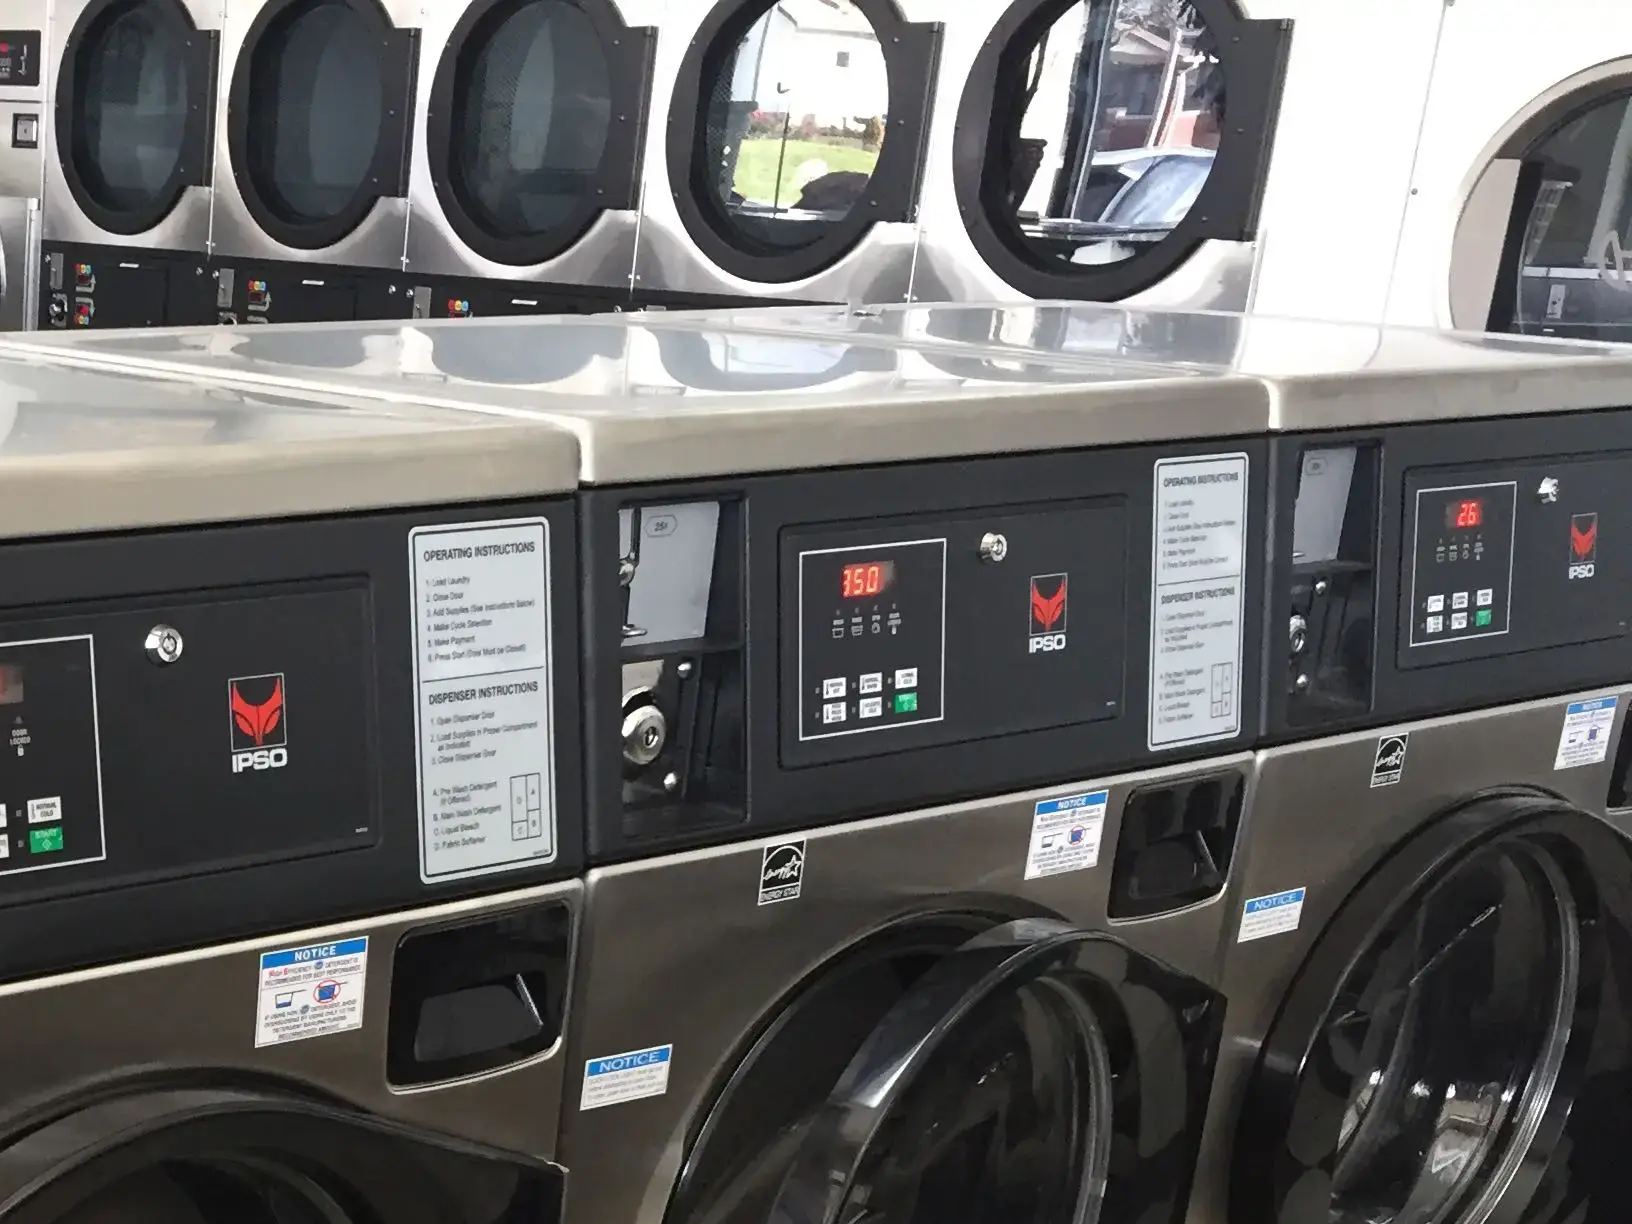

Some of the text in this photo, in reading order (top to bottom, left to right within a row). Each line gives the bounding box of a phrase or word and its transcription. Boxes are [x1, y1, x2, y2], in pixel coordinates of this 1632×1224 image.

[1457, 502, 1477, 527] 26
[423, 541, 535, 562] OPERATING INSTRUCTIONS
[1028, 633, 1066, 654] IPSO
[428, 680, 538, 705] DISPENSER INSTRUCTIONS
[231, 748, 287, 773] IPSO
[1254, 892, 1296, 911] NOTICE
[294, 945, 336, 962] NOTICE
[599, 1051, 660, 1073] NOTICE
